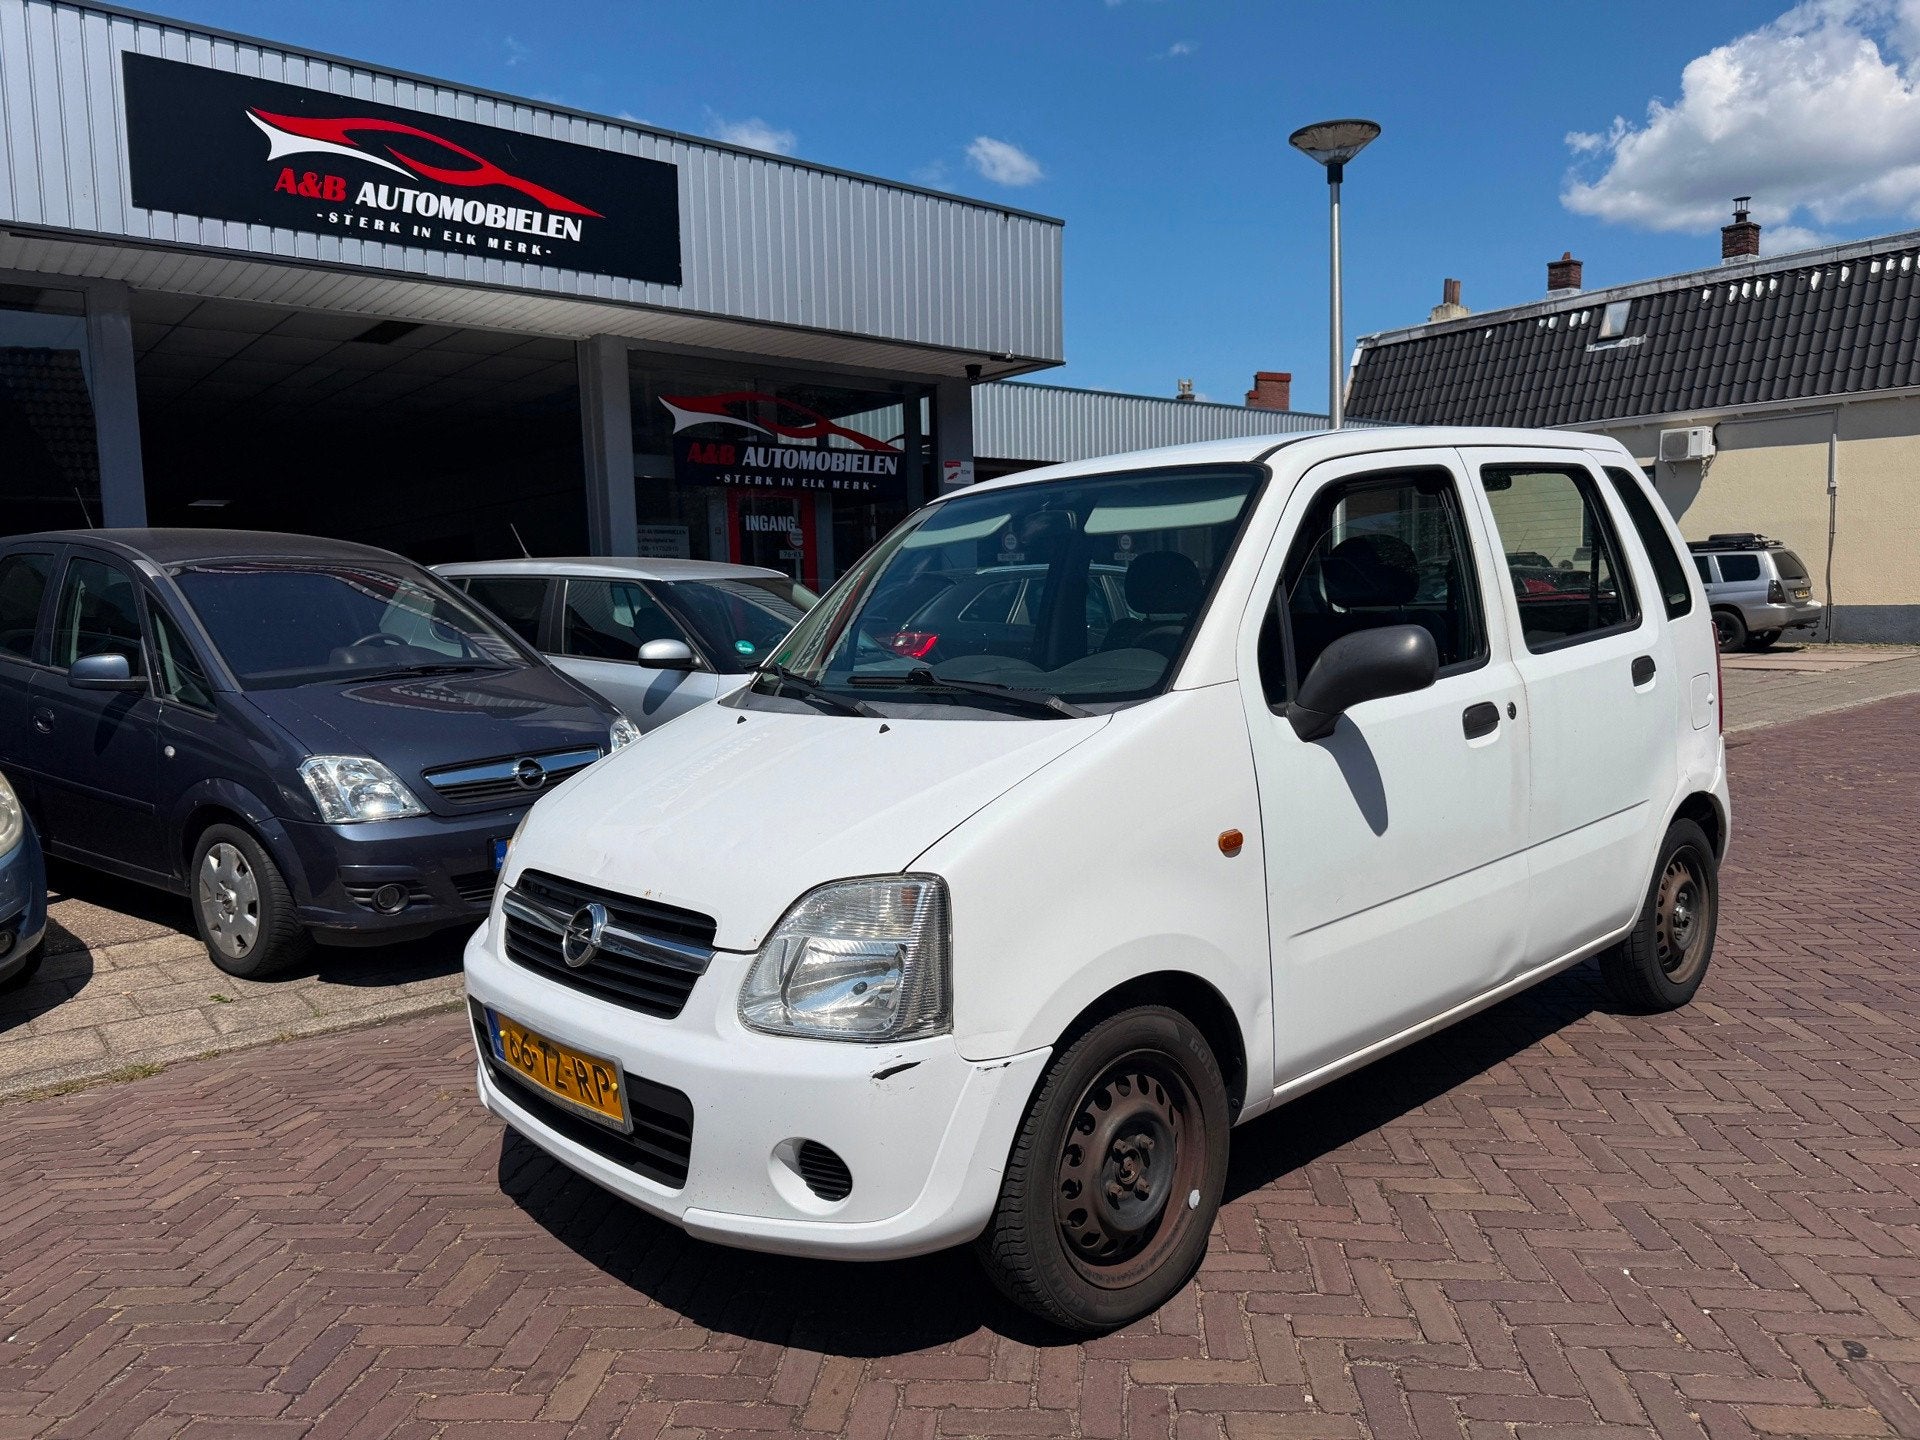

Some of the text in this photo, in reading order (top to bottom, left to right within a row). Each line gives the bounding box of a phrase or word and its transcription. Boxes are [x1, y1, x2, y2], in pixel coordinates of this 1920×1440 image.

[274, 167, 582, 242] A&B AUTOMOBIELEN
[412, 225, 431, 238] IN
[443, 230, 476, 245] ELK
[687, 442, 898, 475] A&B AUTOMOBIELEN
[781, 477, 794, 487] IN
[802, 478, 825, 488] ELK
[745, 515, 796, 532] INGANG
